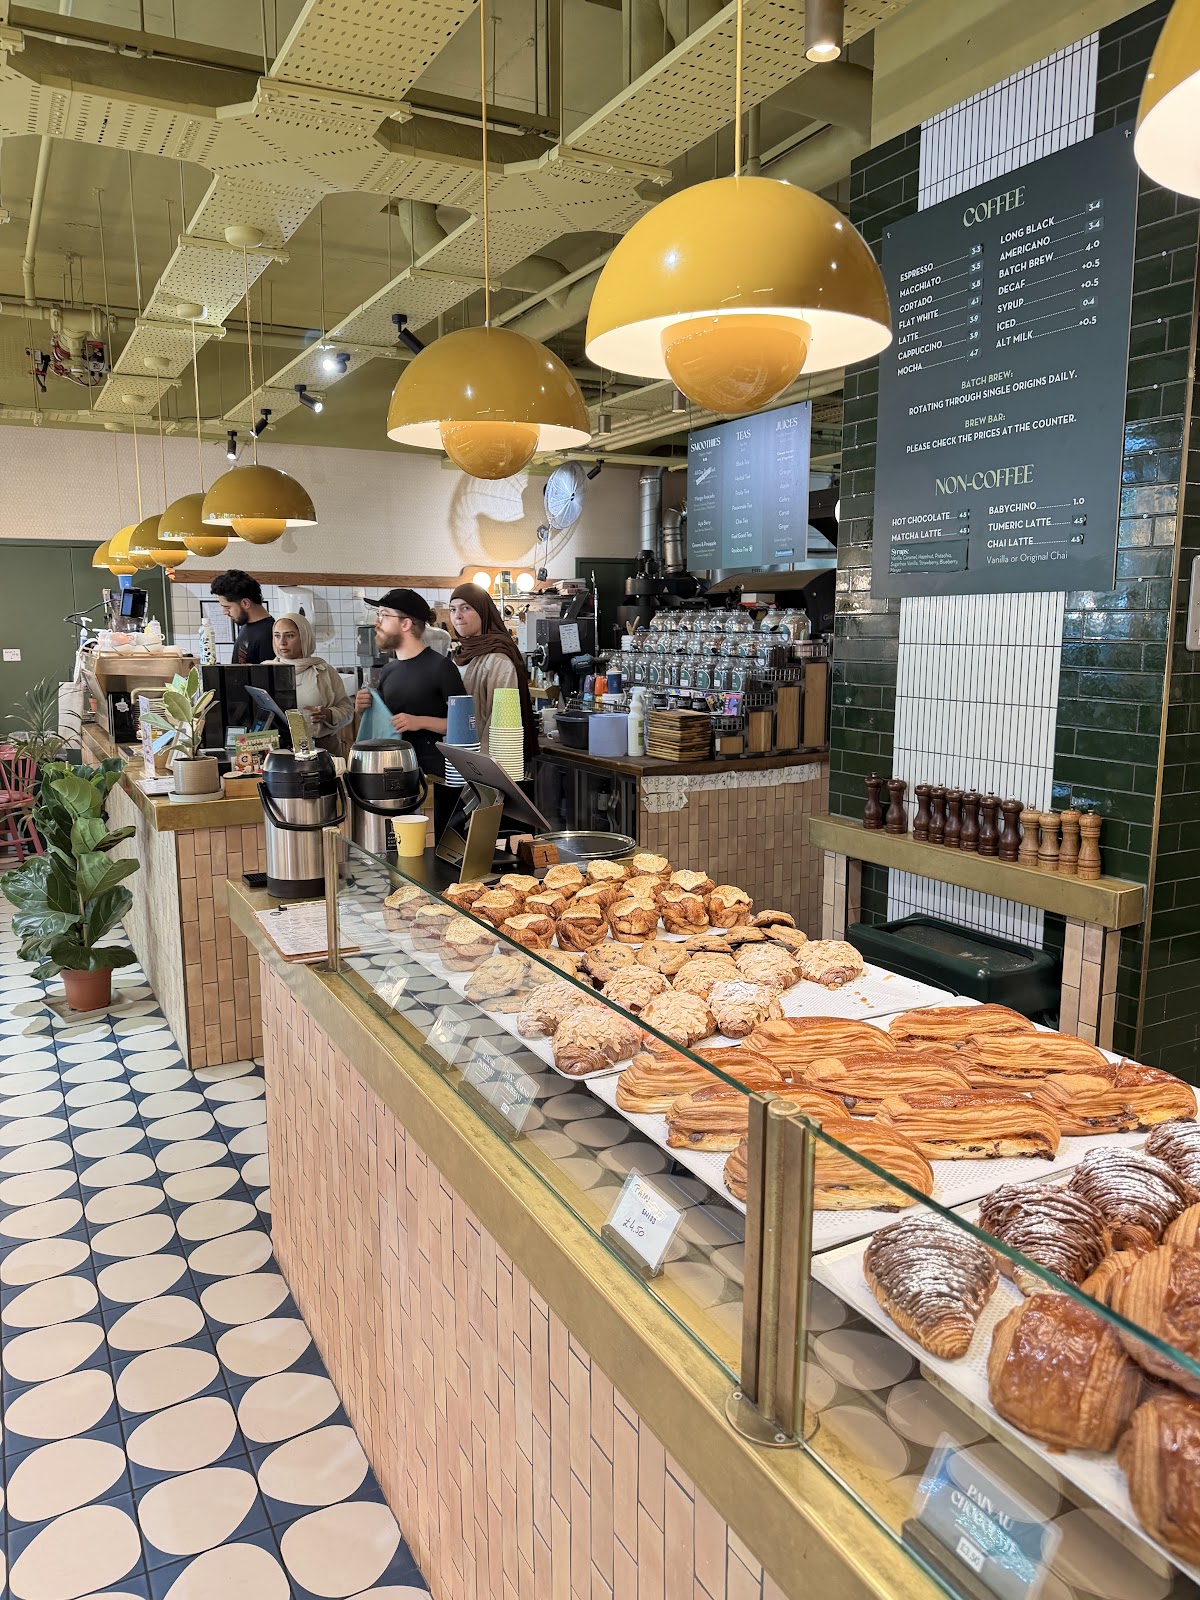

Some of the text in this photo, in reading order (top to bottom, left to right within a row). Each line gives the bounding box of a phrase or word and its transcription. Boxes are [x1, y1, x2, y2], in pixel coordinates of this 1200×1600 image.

[963, 185, 1026, 227] COFFEE
[1000, 228, 1024, 244] LONG
[1026, 216, 1055, 235] BLACK
[999, 236, 1051, 262] AMERICANO
[999, 240, 1100, 279] BATCH BREW 4.0
[899, 262, 981, 298] MACCHIATO 3.5
[900, 262, 934, 282] ESPRESSO
[998, 258, 1100, 296] DECAF +0.5
[899, 295, 933, 313] CORTADO
[997, 278, 1099, 314] SYRUP +0.5
[898, 316, 915, 330] FLAT
[916, 309, 939, 323] WHITE
[996, 318, 1016, 332] ICED
[898, 331, 919, 345] LATTE
[995, 315, 1097, 348] ALT MILK +0.5
[898, 340, 943, 361] CAPPUCCINO
[897, 362, 923, 376] MOCHA
[961, 369, 1013, 390] BATCH BREW:
[909, 369, 1078, 416] ROTATING THROUGH SINGLE ORIGINS DAILY.
[775, 416, 798, 431] JUICES
[964, 412, 1006, 429] BREW BAR:
[736, 429, 751, 441] TEAS
[906, 413, 1077, 454] PLEASE CHECK THE PRICES AT THE COUNTER.
[690, 437, 721, 453] SMOOTHIES
[935, 463, 1035, 496] NON-COFFEE
[988, 497, 1085, 515] BABYCHINO 1.0
[892, 517, 907, 527] HOT
[907, 511, 951, 525] CHOCOLATE
[988, 520, 1024, 532] TUMERIC
[1025, 517, 1052, 528] LATTE
[891, 532, 919, 542] MATCHA
[920, 528, 942, 539] LATTE
[987, 538, 1007, 548] CHAI
[1008, 536, 1034, 547] LATTE
[986, 554, 1009, 564] Vanilla
[1019, 552, 1049, 564] Original
[1050, 550, 1068, 560] Chai
[542, 850, 550, 862] 1
[622, 1216, 645, 1238] £4.50
[966, 1483, 1014, 1532] PAIN AU
